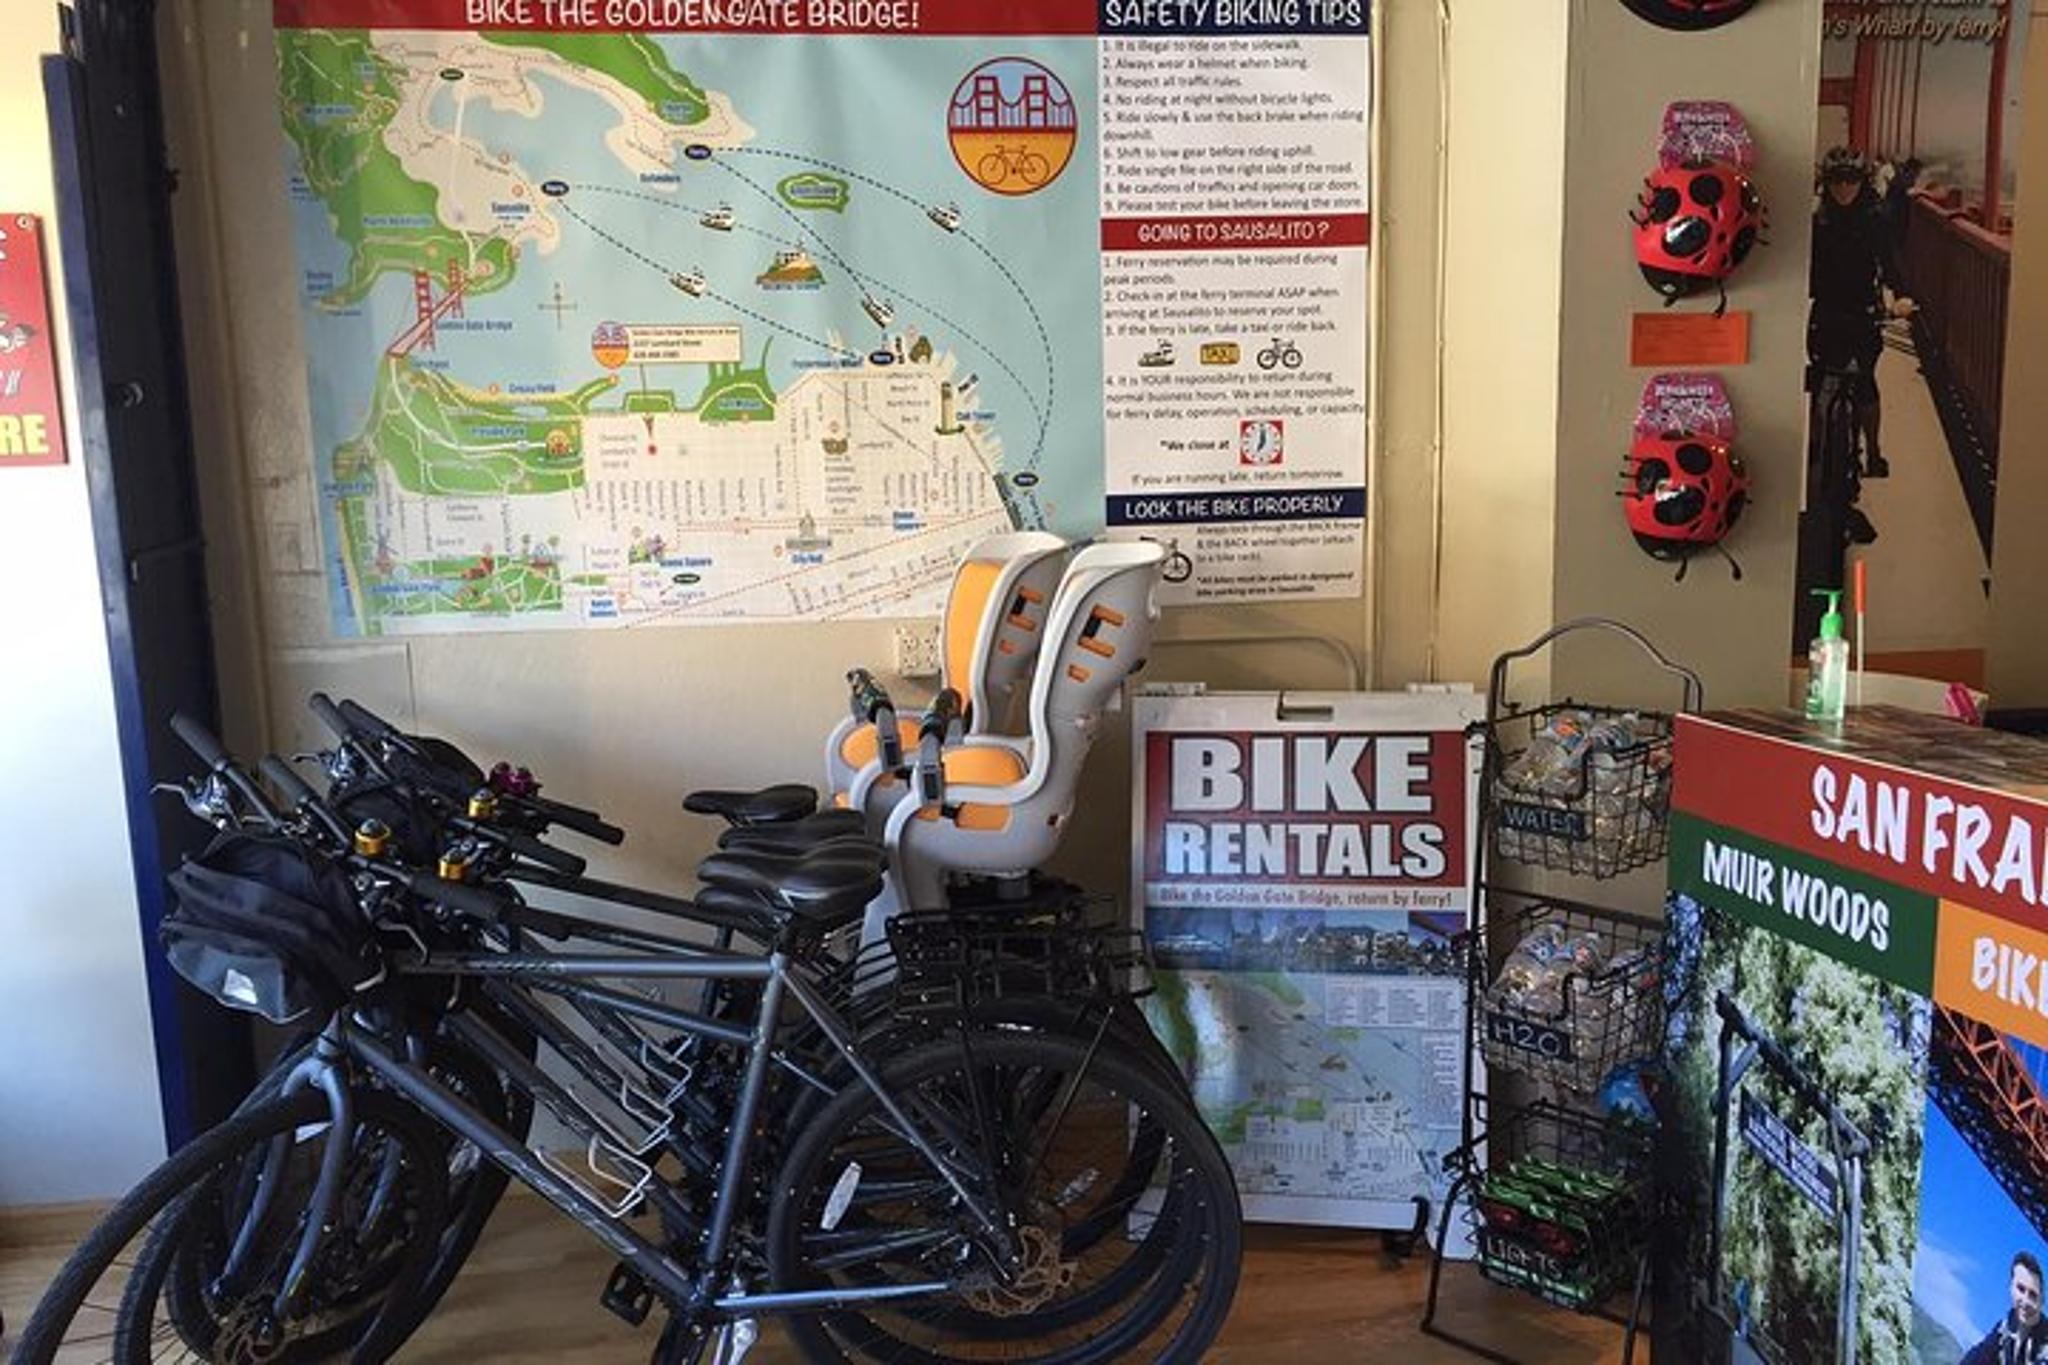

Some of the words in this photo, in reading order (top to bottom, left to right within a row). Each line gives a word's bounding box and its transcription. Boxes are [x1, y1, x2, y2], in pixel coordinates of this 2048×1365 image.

[466, 0, 534, 23] BIKE
[539, 0, 599, 25] THE
[605, 0, 725, 26] GOLDEN
[727, 1, 800, 27] GATE
[808, 1, 919, 28] BRIDGE!
[1106, 0, 1209, 26] SAFETY
[1214, 0, 1300, 25] BIKING
[1308, 0, 1362, 25] TIPS
[1923, 15, 1948, 45] by
[1138, 224, 1192, 243] GOING
[1196, 223, 1218, 241] TO
[1219, 221, 1314, 241] SAUSALITO
[1318, 221, 1331, 239] ?
[1126, 499, 1172, 519] LOCK
[1176, 498, 1209, 517] THE
[1212, 498, 1249, 516] BIKE
[1254, 495, 1344, 515] PROPERLY
[1170, 736, 1433, 813] BIKE
[1504, 805, 1579, 834] WATER
[1811, 764, 1910, 865] SAN
[1922, 792, 2048, 906] FRA
[1163, 822, 1447, 879] RENTALS
[1160, 887, 1187, 901] Bike
[1191, 887, 1213, 901] the
[1214, 888, 1261, 902] Golden
[1263, 888, 1295, 903] Gate
[1348, 891, 1389, 905] return
[1393, 890, 1408, 907] by
[1703, 839, 1775, 907] MUIR
[1782, 865, 1890, 952] WOODS
[1495, 1021, 1560, 1056] H2O
